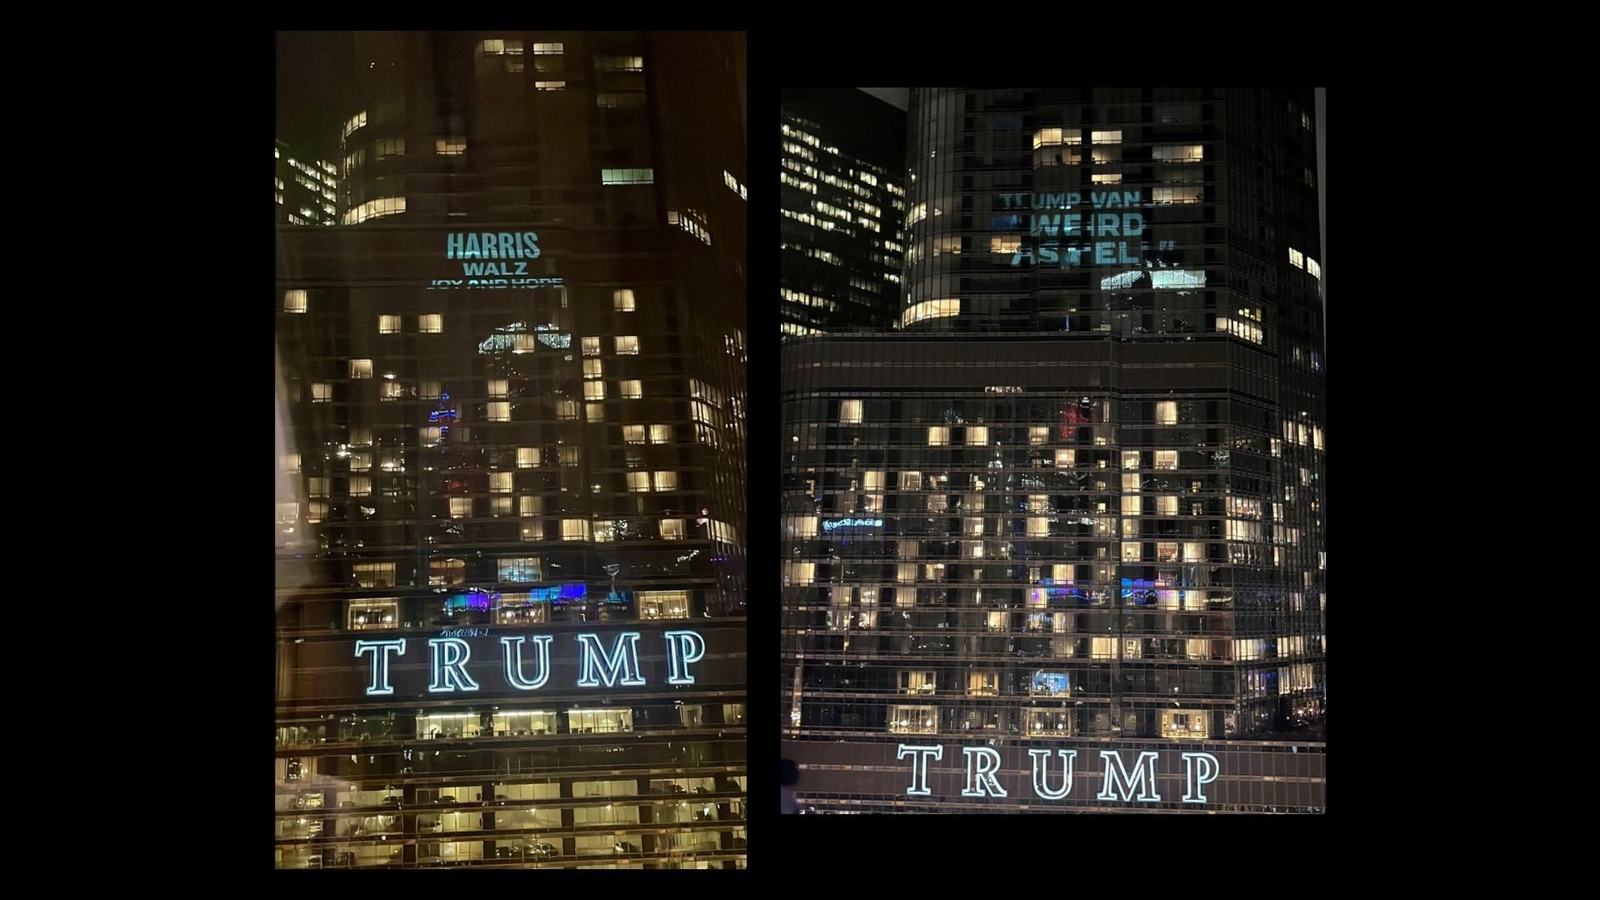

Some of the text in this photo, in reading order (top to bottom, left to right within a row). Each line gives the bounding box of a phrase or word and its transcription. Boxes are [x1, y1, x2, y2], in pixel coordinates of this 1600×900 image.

[447, 232, 541, 259] HARRIS
[1011, 241, 1058, 266] AS
[462, 262, 528, 276] WALZ
[467, 279, 508, 289] AND
[511, 278, 565, 288] HOPE
[354, 630, 705, 695] TRUMP
[897, 743, 1220, 803] TRUMP
